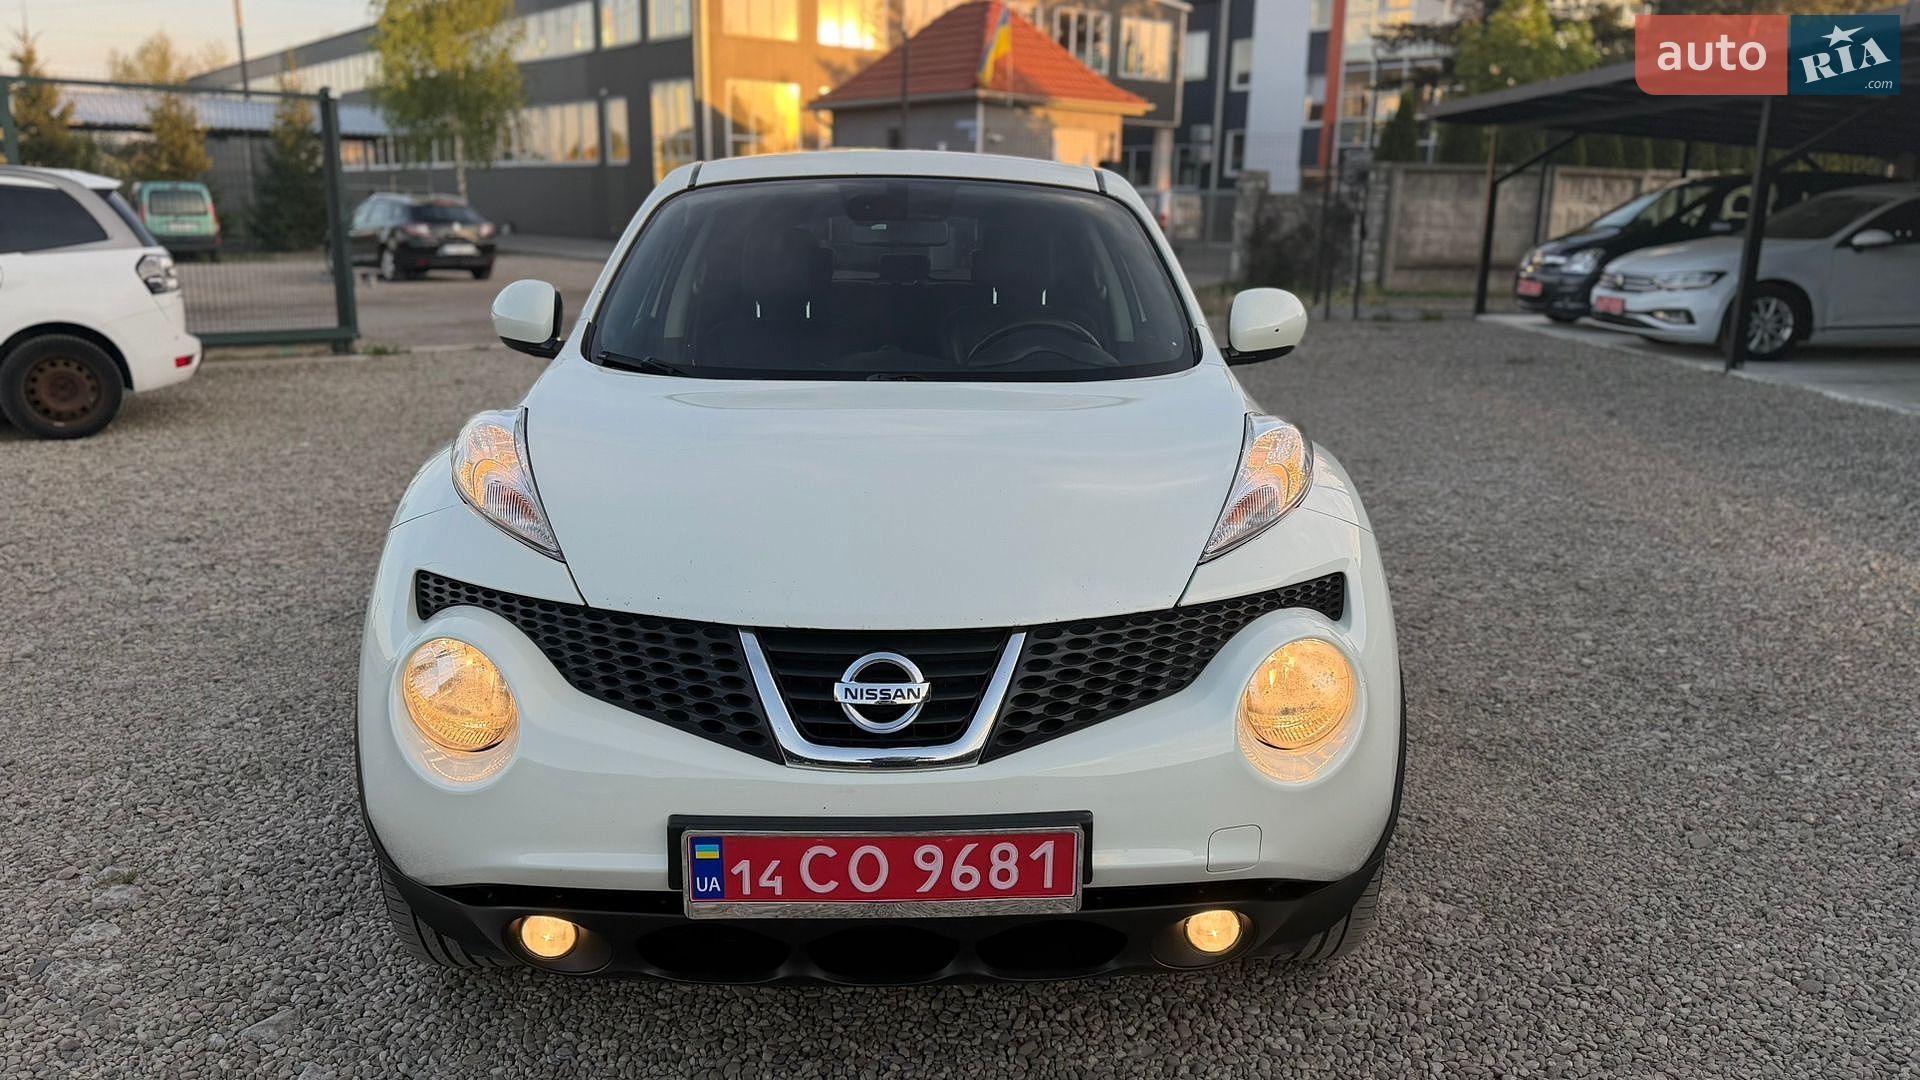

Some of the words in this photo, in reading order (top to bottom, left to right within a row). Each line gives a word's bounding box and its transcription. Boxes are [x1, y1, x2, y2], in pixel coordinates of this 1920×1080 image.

[844, 687, 921, 700] NISSAN
[731, 859, 782, 896] 14
[800, 844, 889, 893] CO
[913, 840, 1055, 893] 9681
[696, 877, 720, 892] UA
